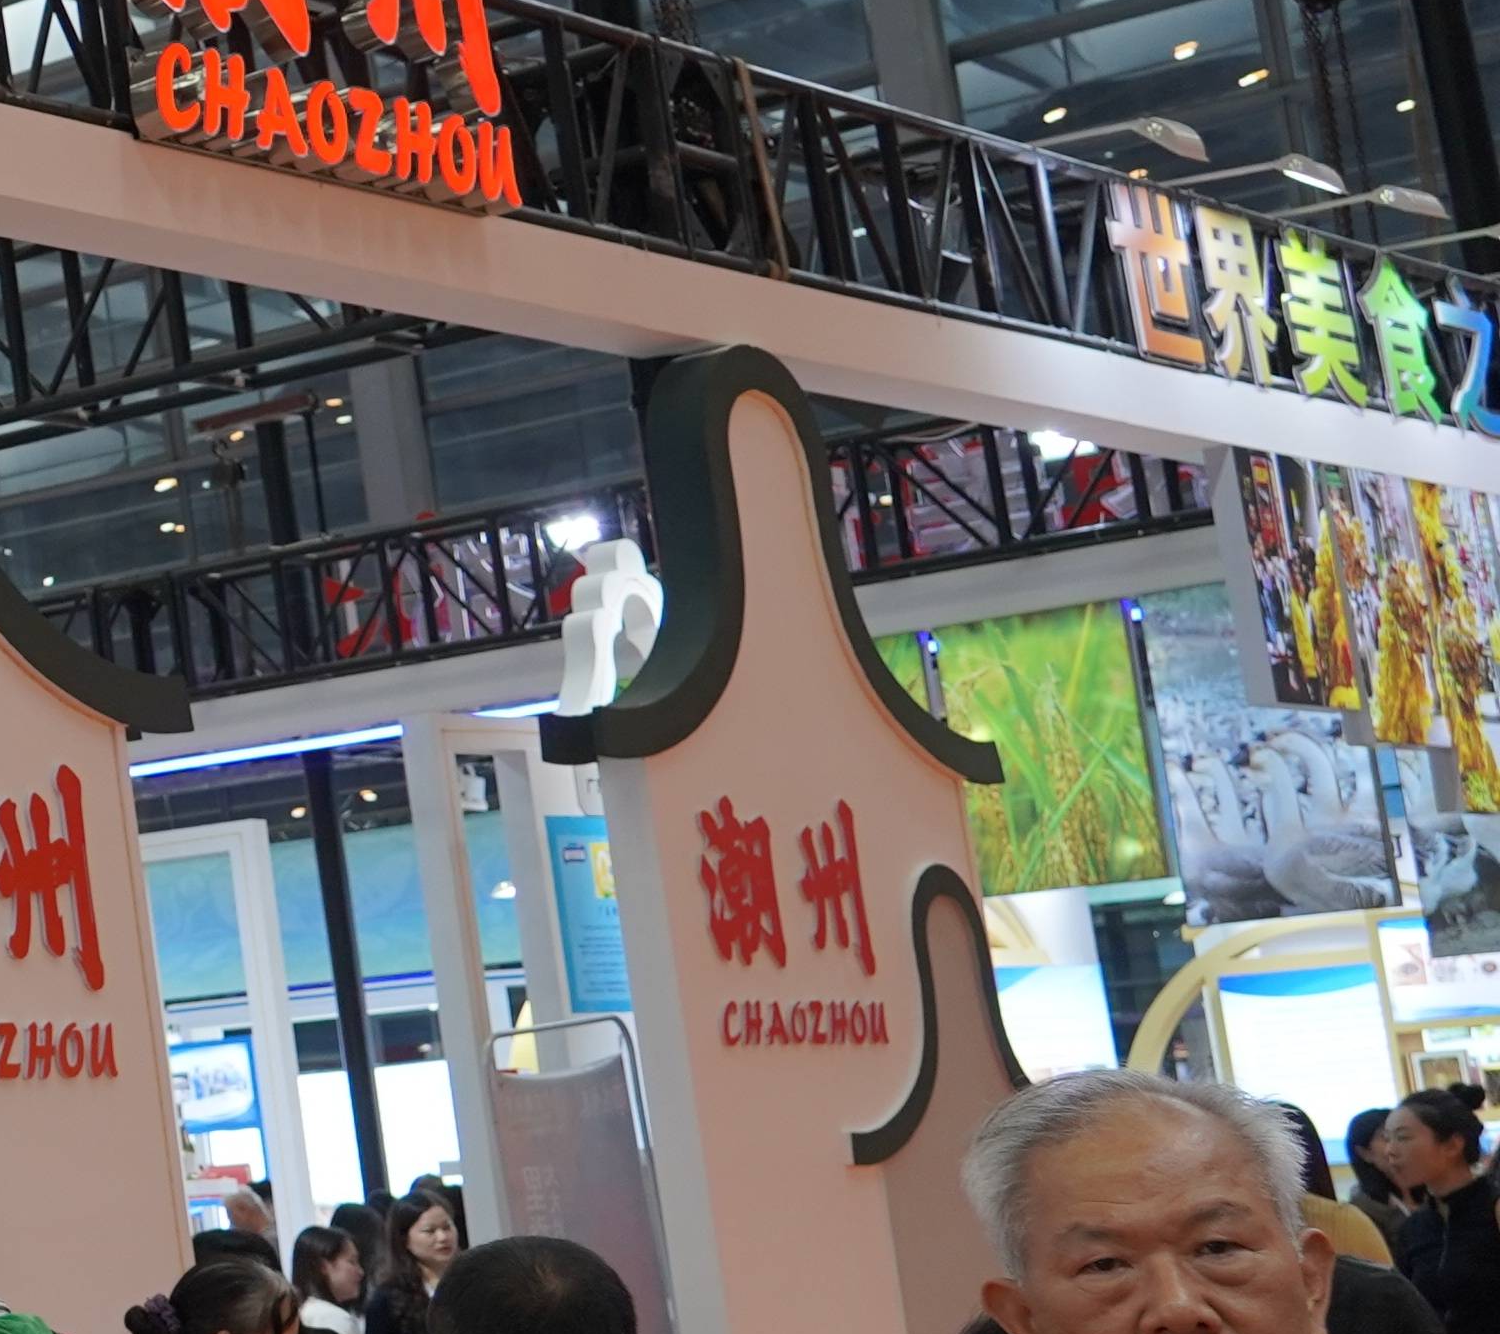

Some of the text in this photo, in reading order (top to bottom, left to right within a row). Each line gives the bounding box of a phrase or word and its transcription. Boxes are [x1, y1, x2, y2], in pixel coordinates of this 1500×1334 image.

[156, 41, 522, 208] CHAOZHOU
[699, 794, 878, 977] 潮州
[722, 999, 890, 1047] CHAOZHOU
